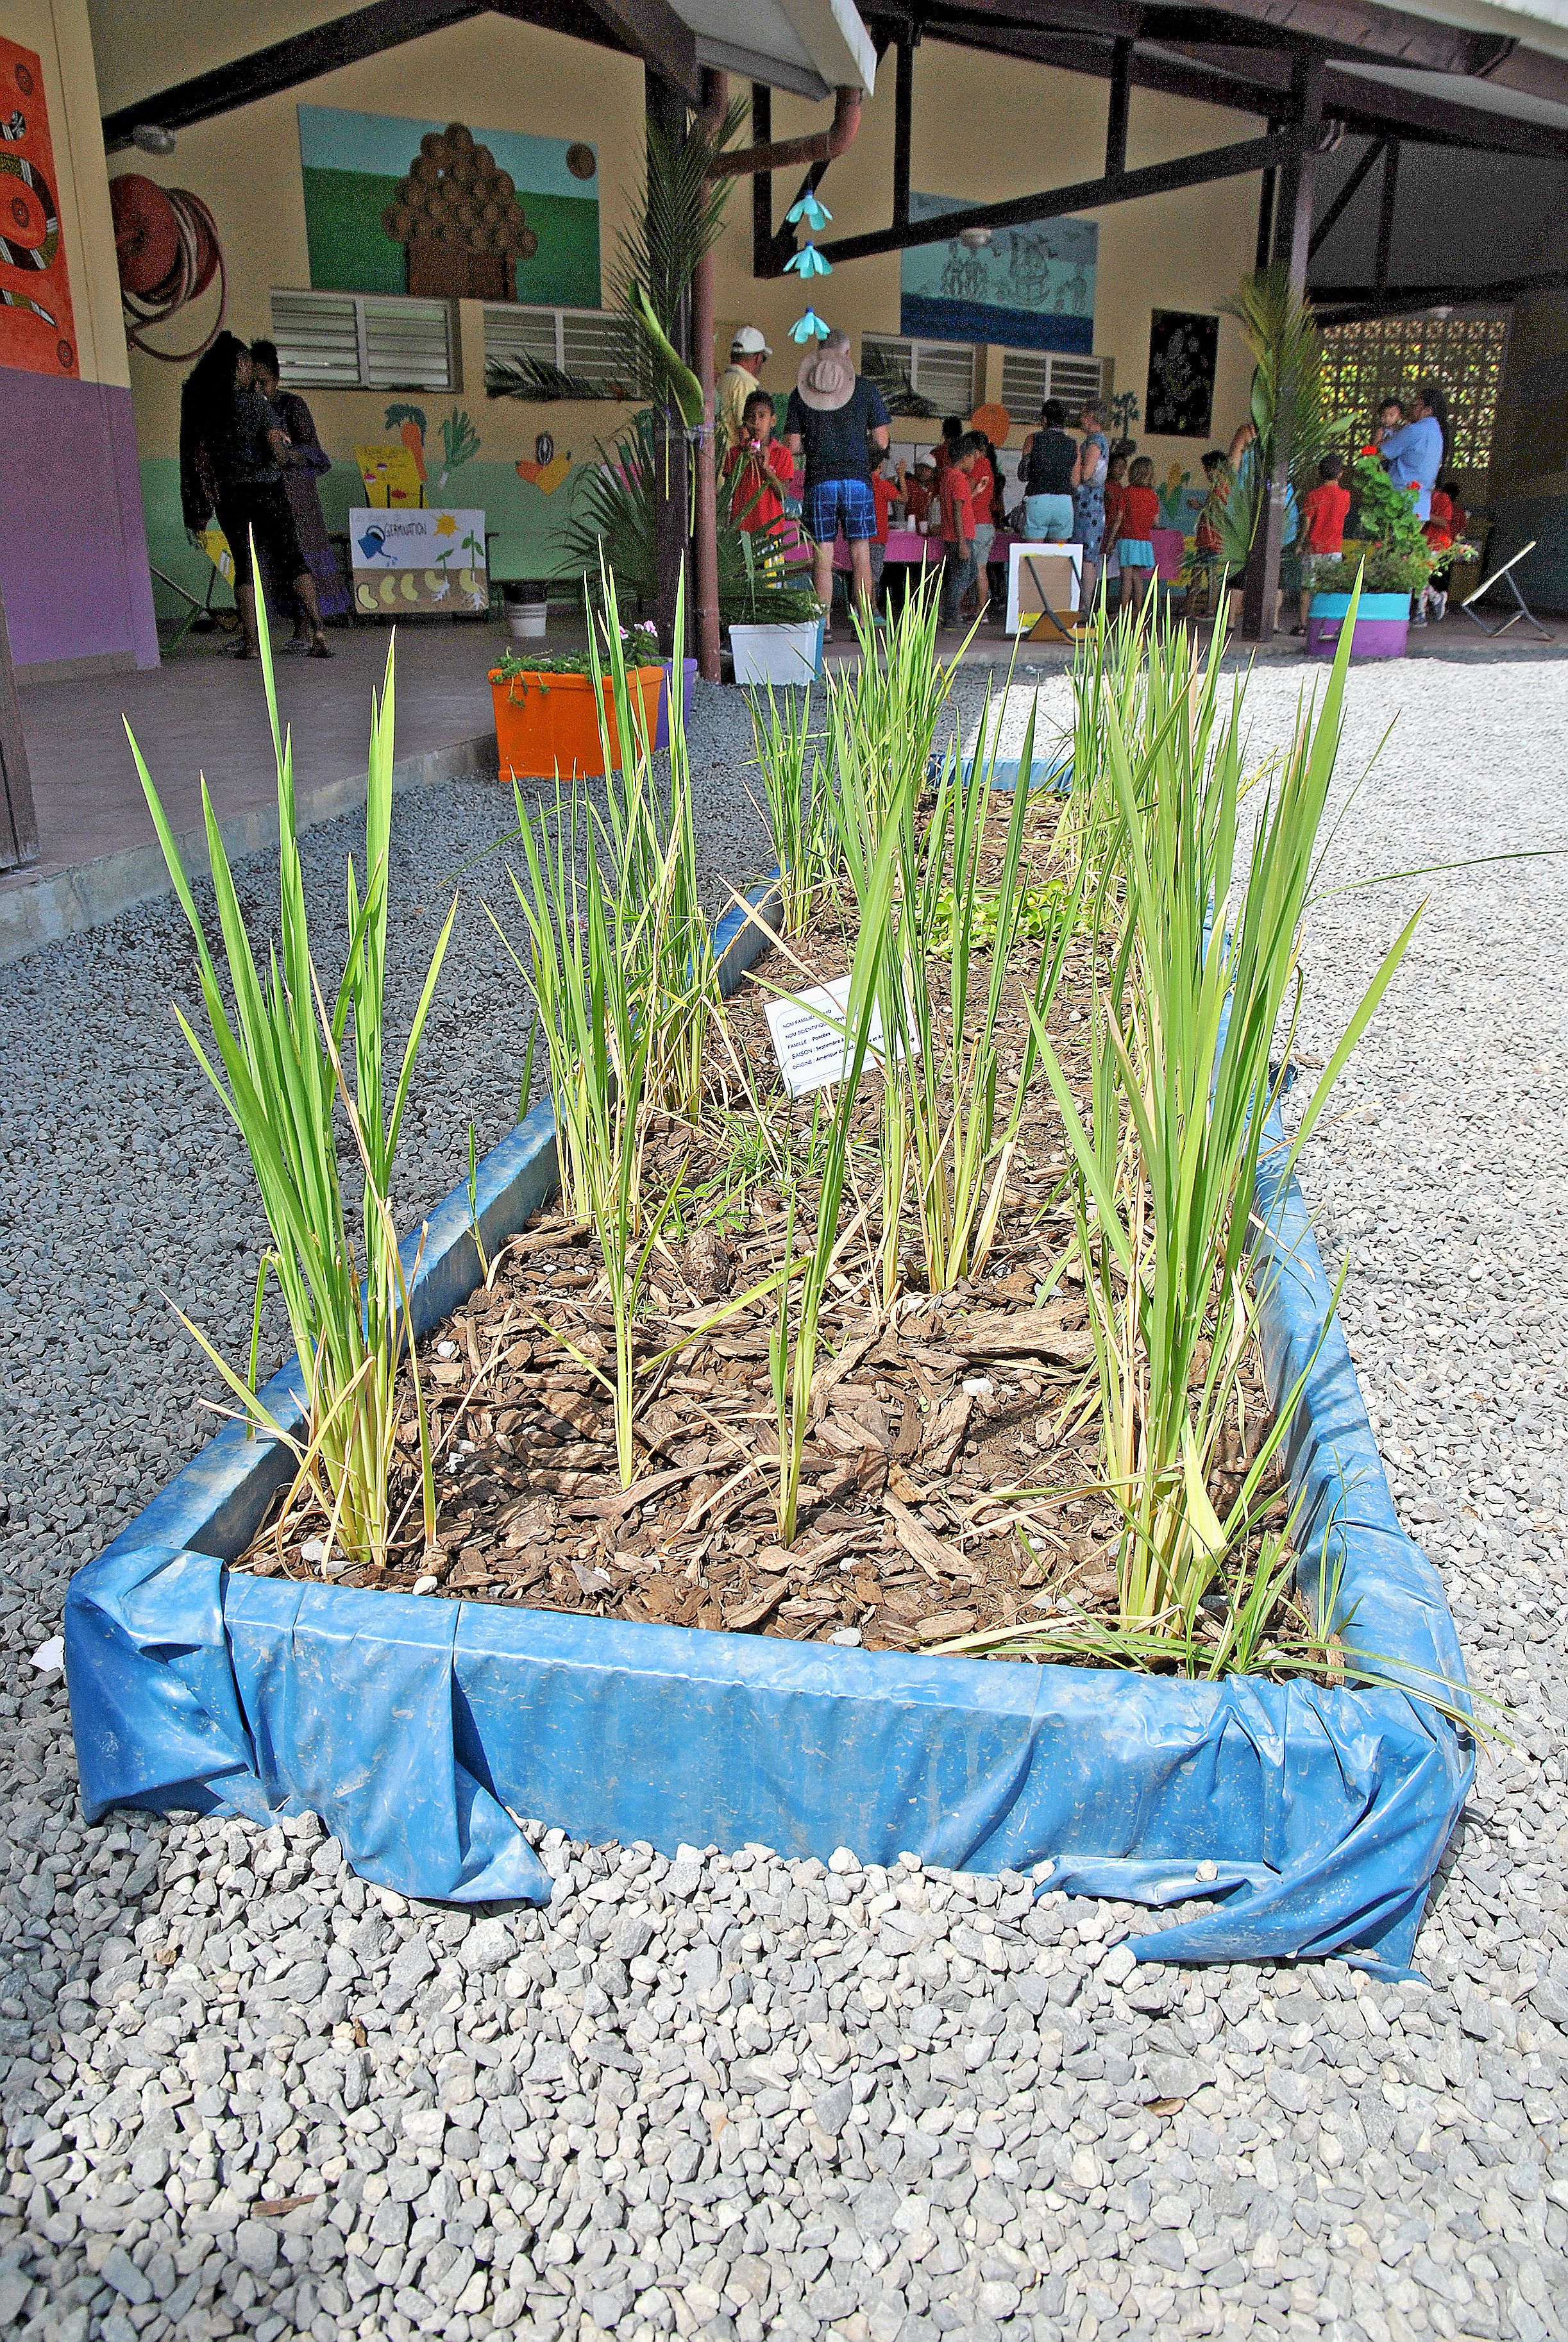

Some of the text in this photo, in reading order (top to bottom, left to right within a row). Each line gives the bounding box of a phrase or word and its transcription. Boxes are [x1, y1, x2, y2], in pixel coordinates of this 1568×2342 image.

[791, 1048, 813, 1059] SAISON
[816, 1040, 840, 1051] Septembre
[792, 1059, 813, 1070] ORIGINE
